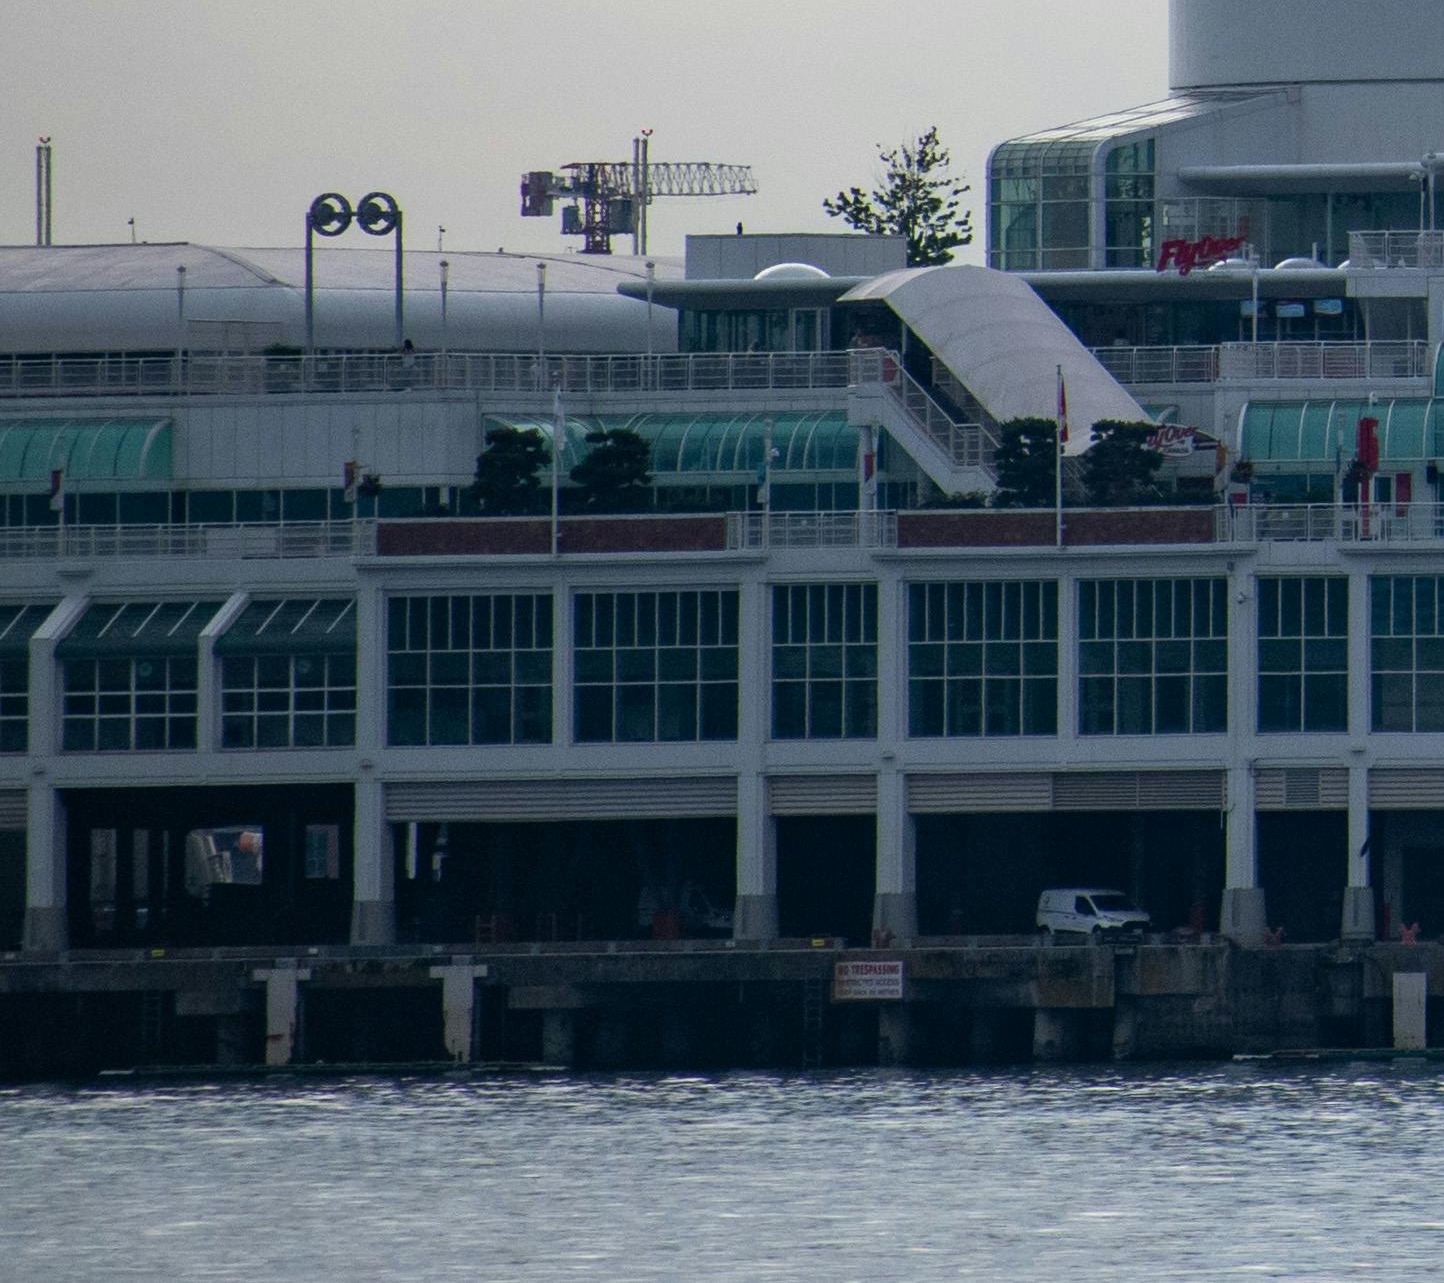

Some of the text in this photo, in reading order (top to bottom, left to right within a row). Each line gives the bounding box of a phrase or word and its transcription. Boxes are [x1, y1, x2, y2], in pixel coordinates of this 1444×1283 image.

[1156, 234, 1246, 276] FlyOver
[837, 964, 899, 975] NO TRESPASSING
